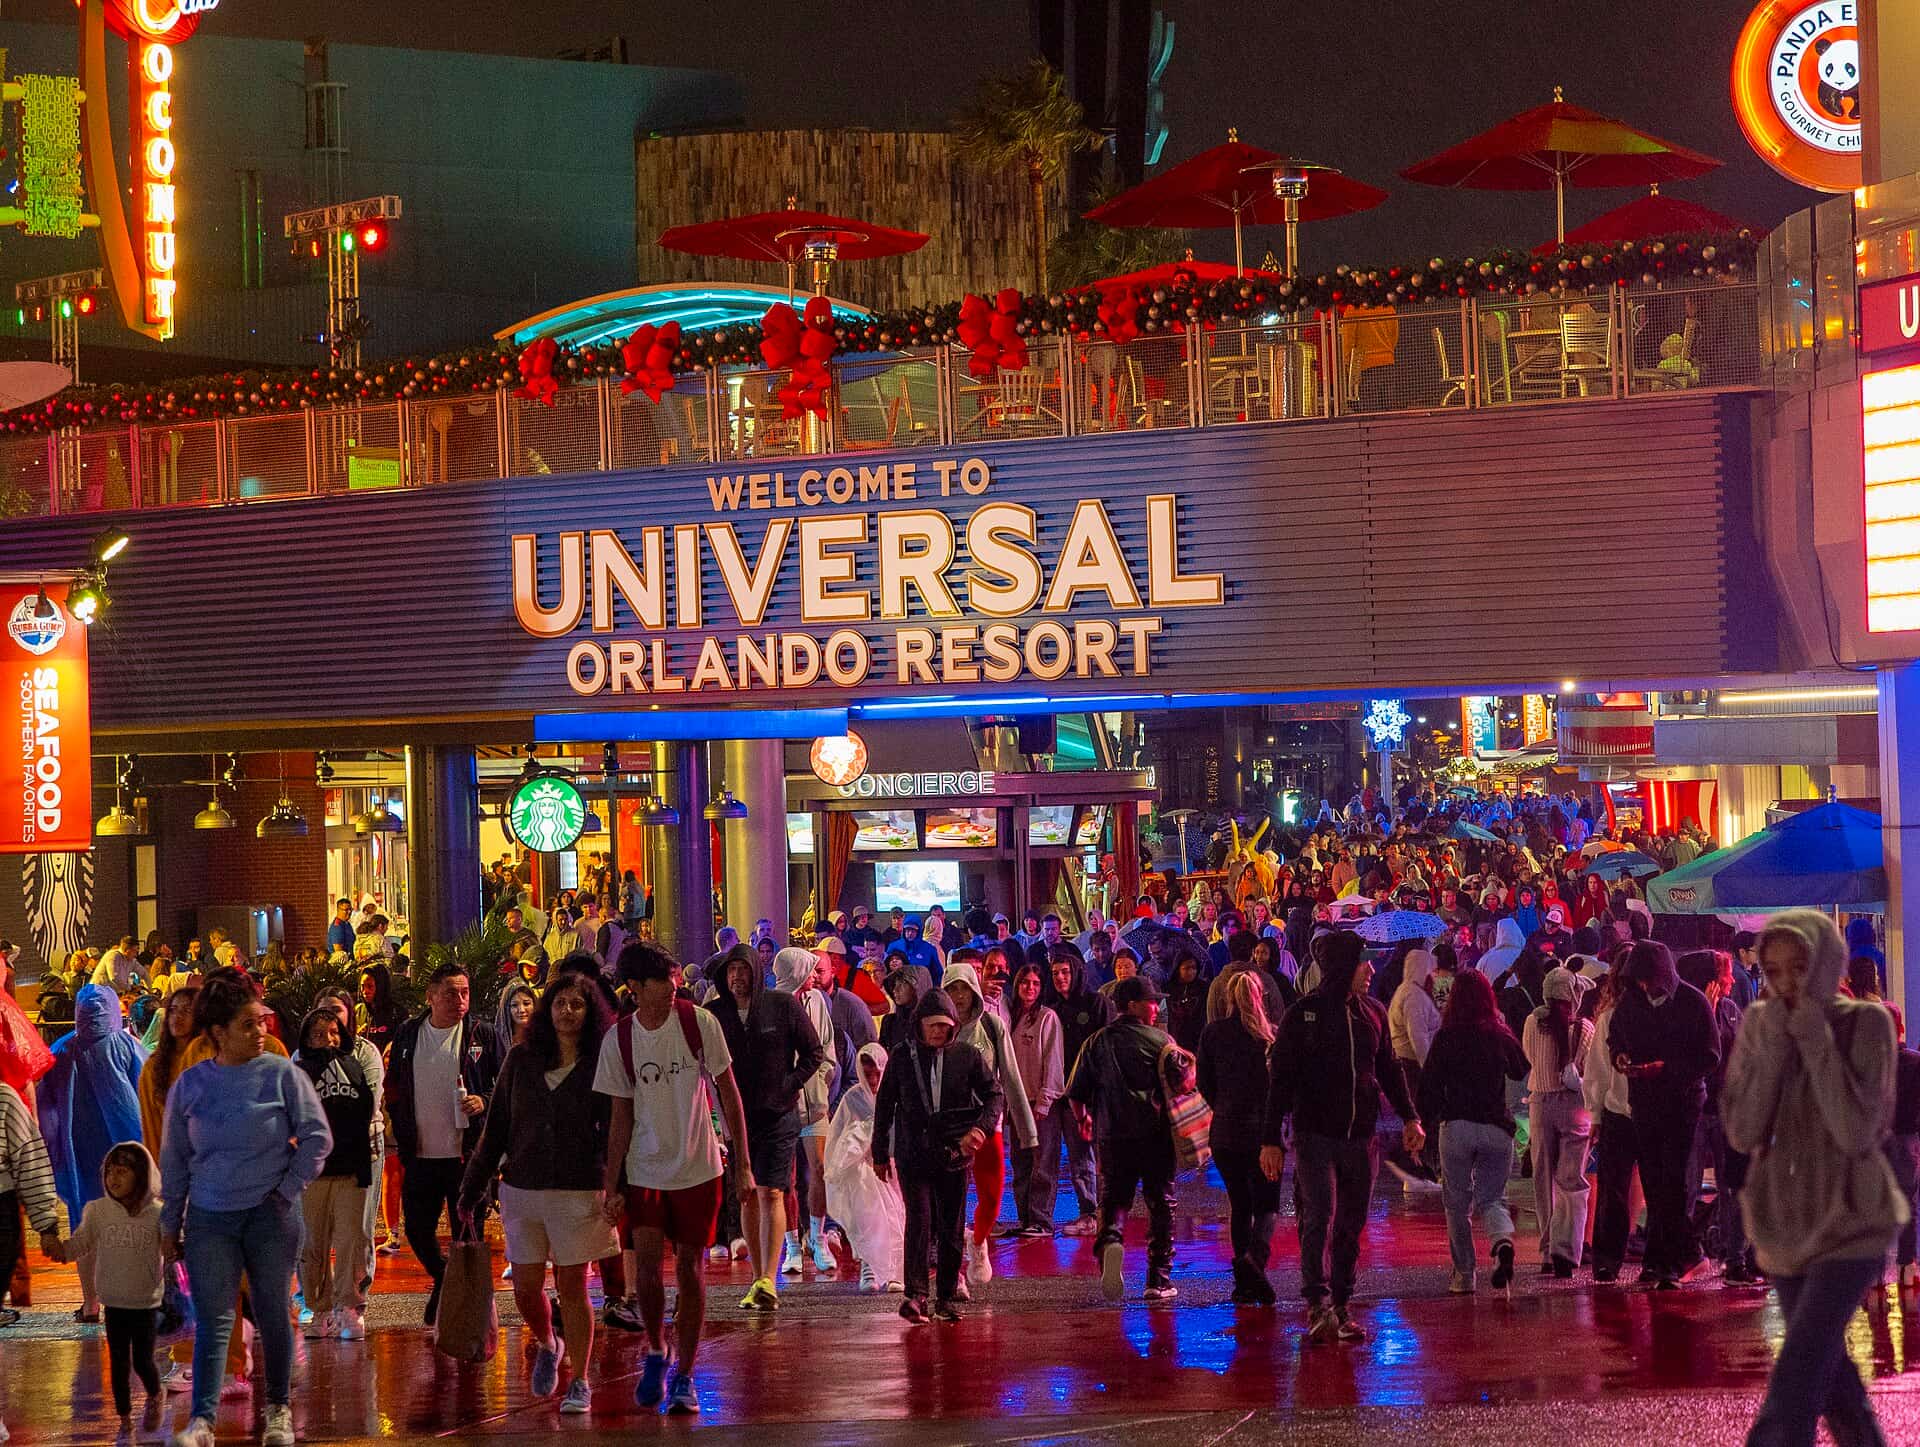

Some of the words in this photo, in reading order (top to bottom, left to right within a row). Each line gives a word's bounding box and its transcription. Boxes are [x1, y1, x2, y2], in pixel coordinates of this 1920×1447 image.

[1777, 9, 1833, 78] PANDA
[1842, 4, 1857, 21] E
[1780, 91, 1832, 143] GOURMET
[707, 463, 917, 511] WELCOME
[932, 458, 992, 496] TO
[510, 493, 1225, 639] UNIVERSAL
[566, 629, 872, 696] ORLANDO
[896, 615, 1162, 685] RESORT
[20, 679, 34, 760] SOUTHERN
[33, 667, 62, 833] SEAFOOD
[1527, 694, 1537, 746] DWICHE
[23, 763, 35, 843] FAVORITES
